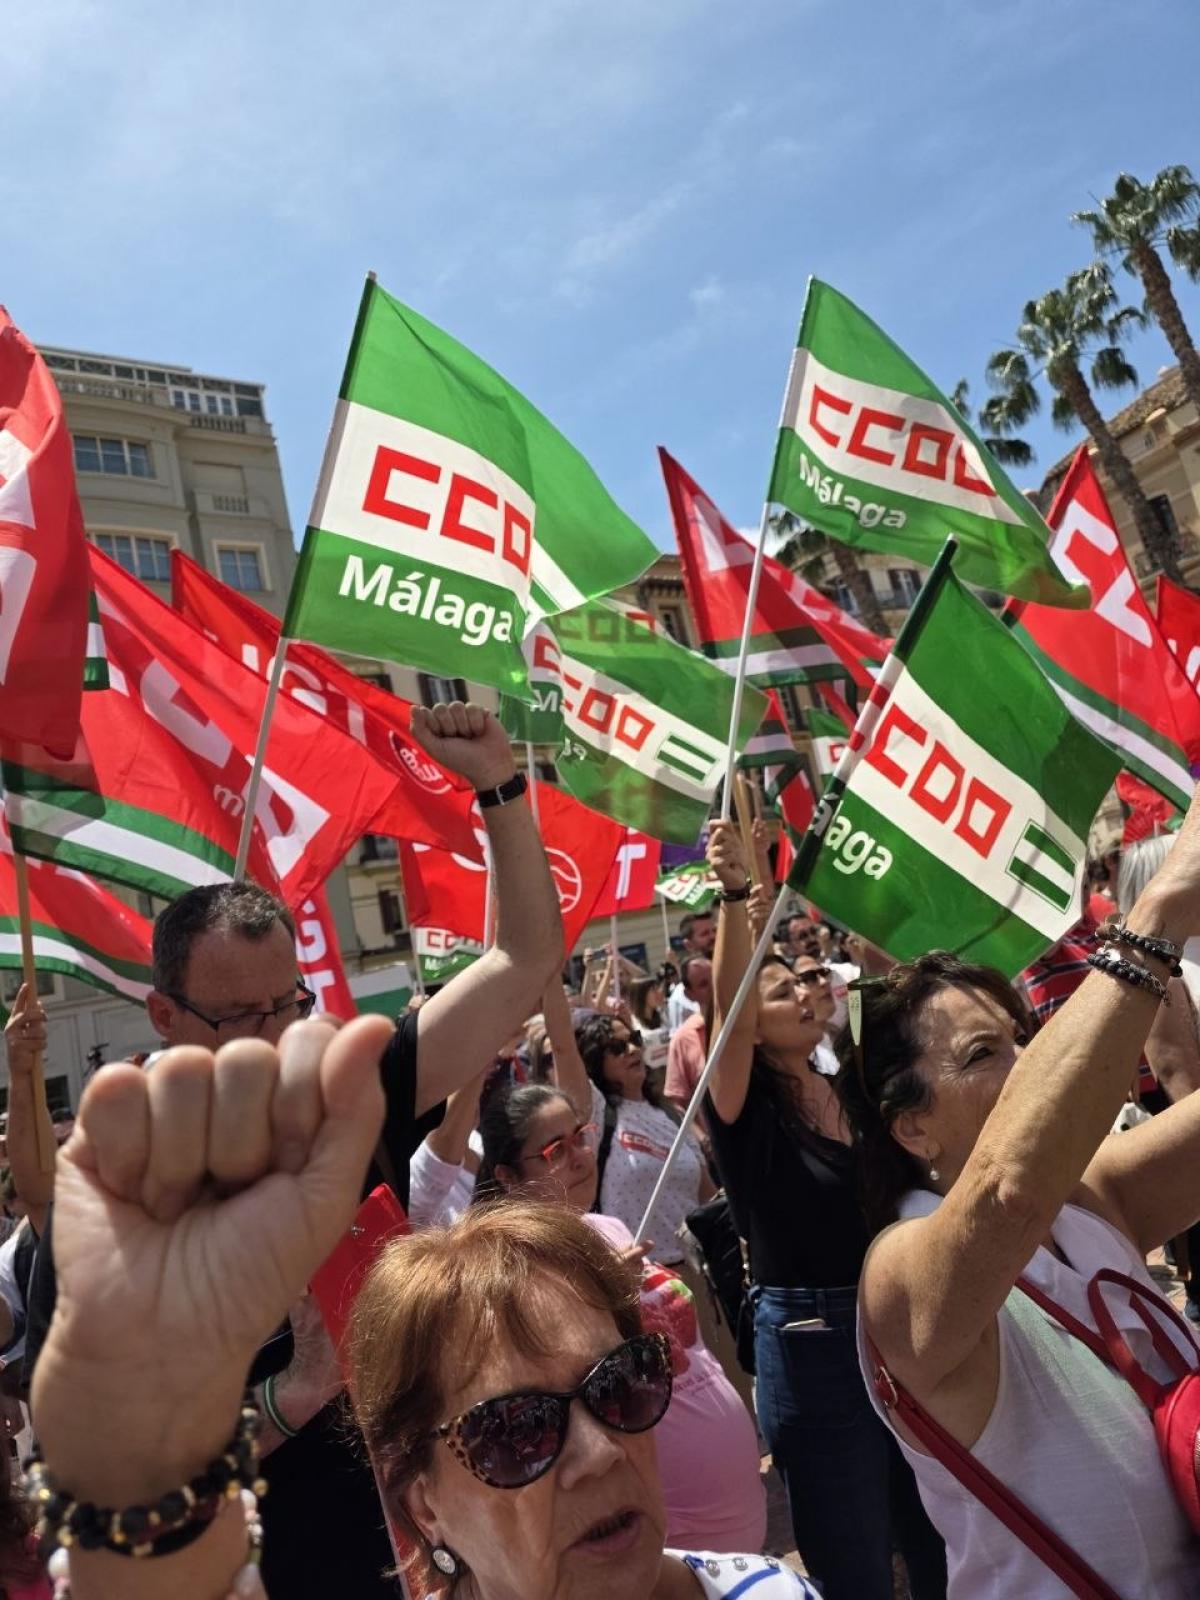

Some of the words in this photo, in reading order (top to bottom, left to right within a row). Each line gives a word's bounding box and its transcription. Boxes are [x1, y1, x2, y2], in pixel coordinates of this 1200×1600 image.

[800, 453, 907, 528] Málaga
[338, 554, 513, 646] Málaga
[850, 682, 1013, 860] COO
